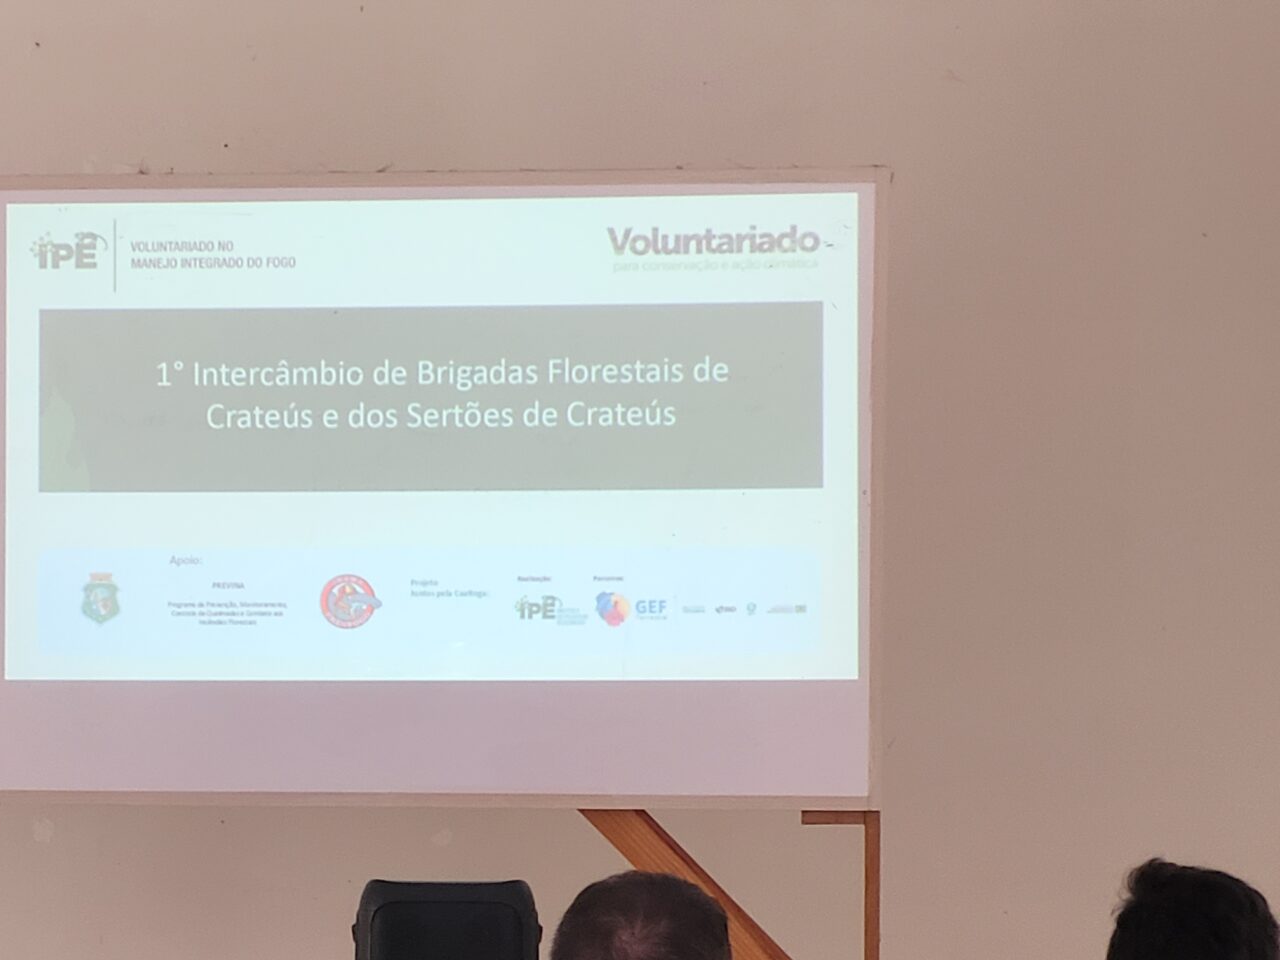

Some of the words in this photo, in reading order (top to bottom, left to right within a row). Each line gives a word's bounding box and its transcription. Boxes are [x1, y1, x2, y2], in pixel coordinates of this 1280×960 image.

[130, 240, 214, 253] VOLUNTARIADO
[217, 240, 234, 252] NO
[607, 224, 821, 256] Voluntariado
[130, 256, 178, 270] MANEJO
[180, 256, 244, 269] INTEGRADO
[246, 256, 263, 269] DO
[266, 256, 296, 268] FOGO
[194, 360, 364, 386] Intercâmbio
[373, 360, 407, 386] de
[418, 358, 538, 391] Brigadas
[548, 357, 684, 384] Florestais
[693, 356, 729, 382] de
[207, 403, 313, 429] Crateús
[322, 410, 339, 429] e
[348, 402, 398, 428] dos
[407, 402, 513, 428] Sertões
[523, 401, 558, 427] de
[567, 400, 677, 426] Crateús
[635, 600, 667, 614] GEF
